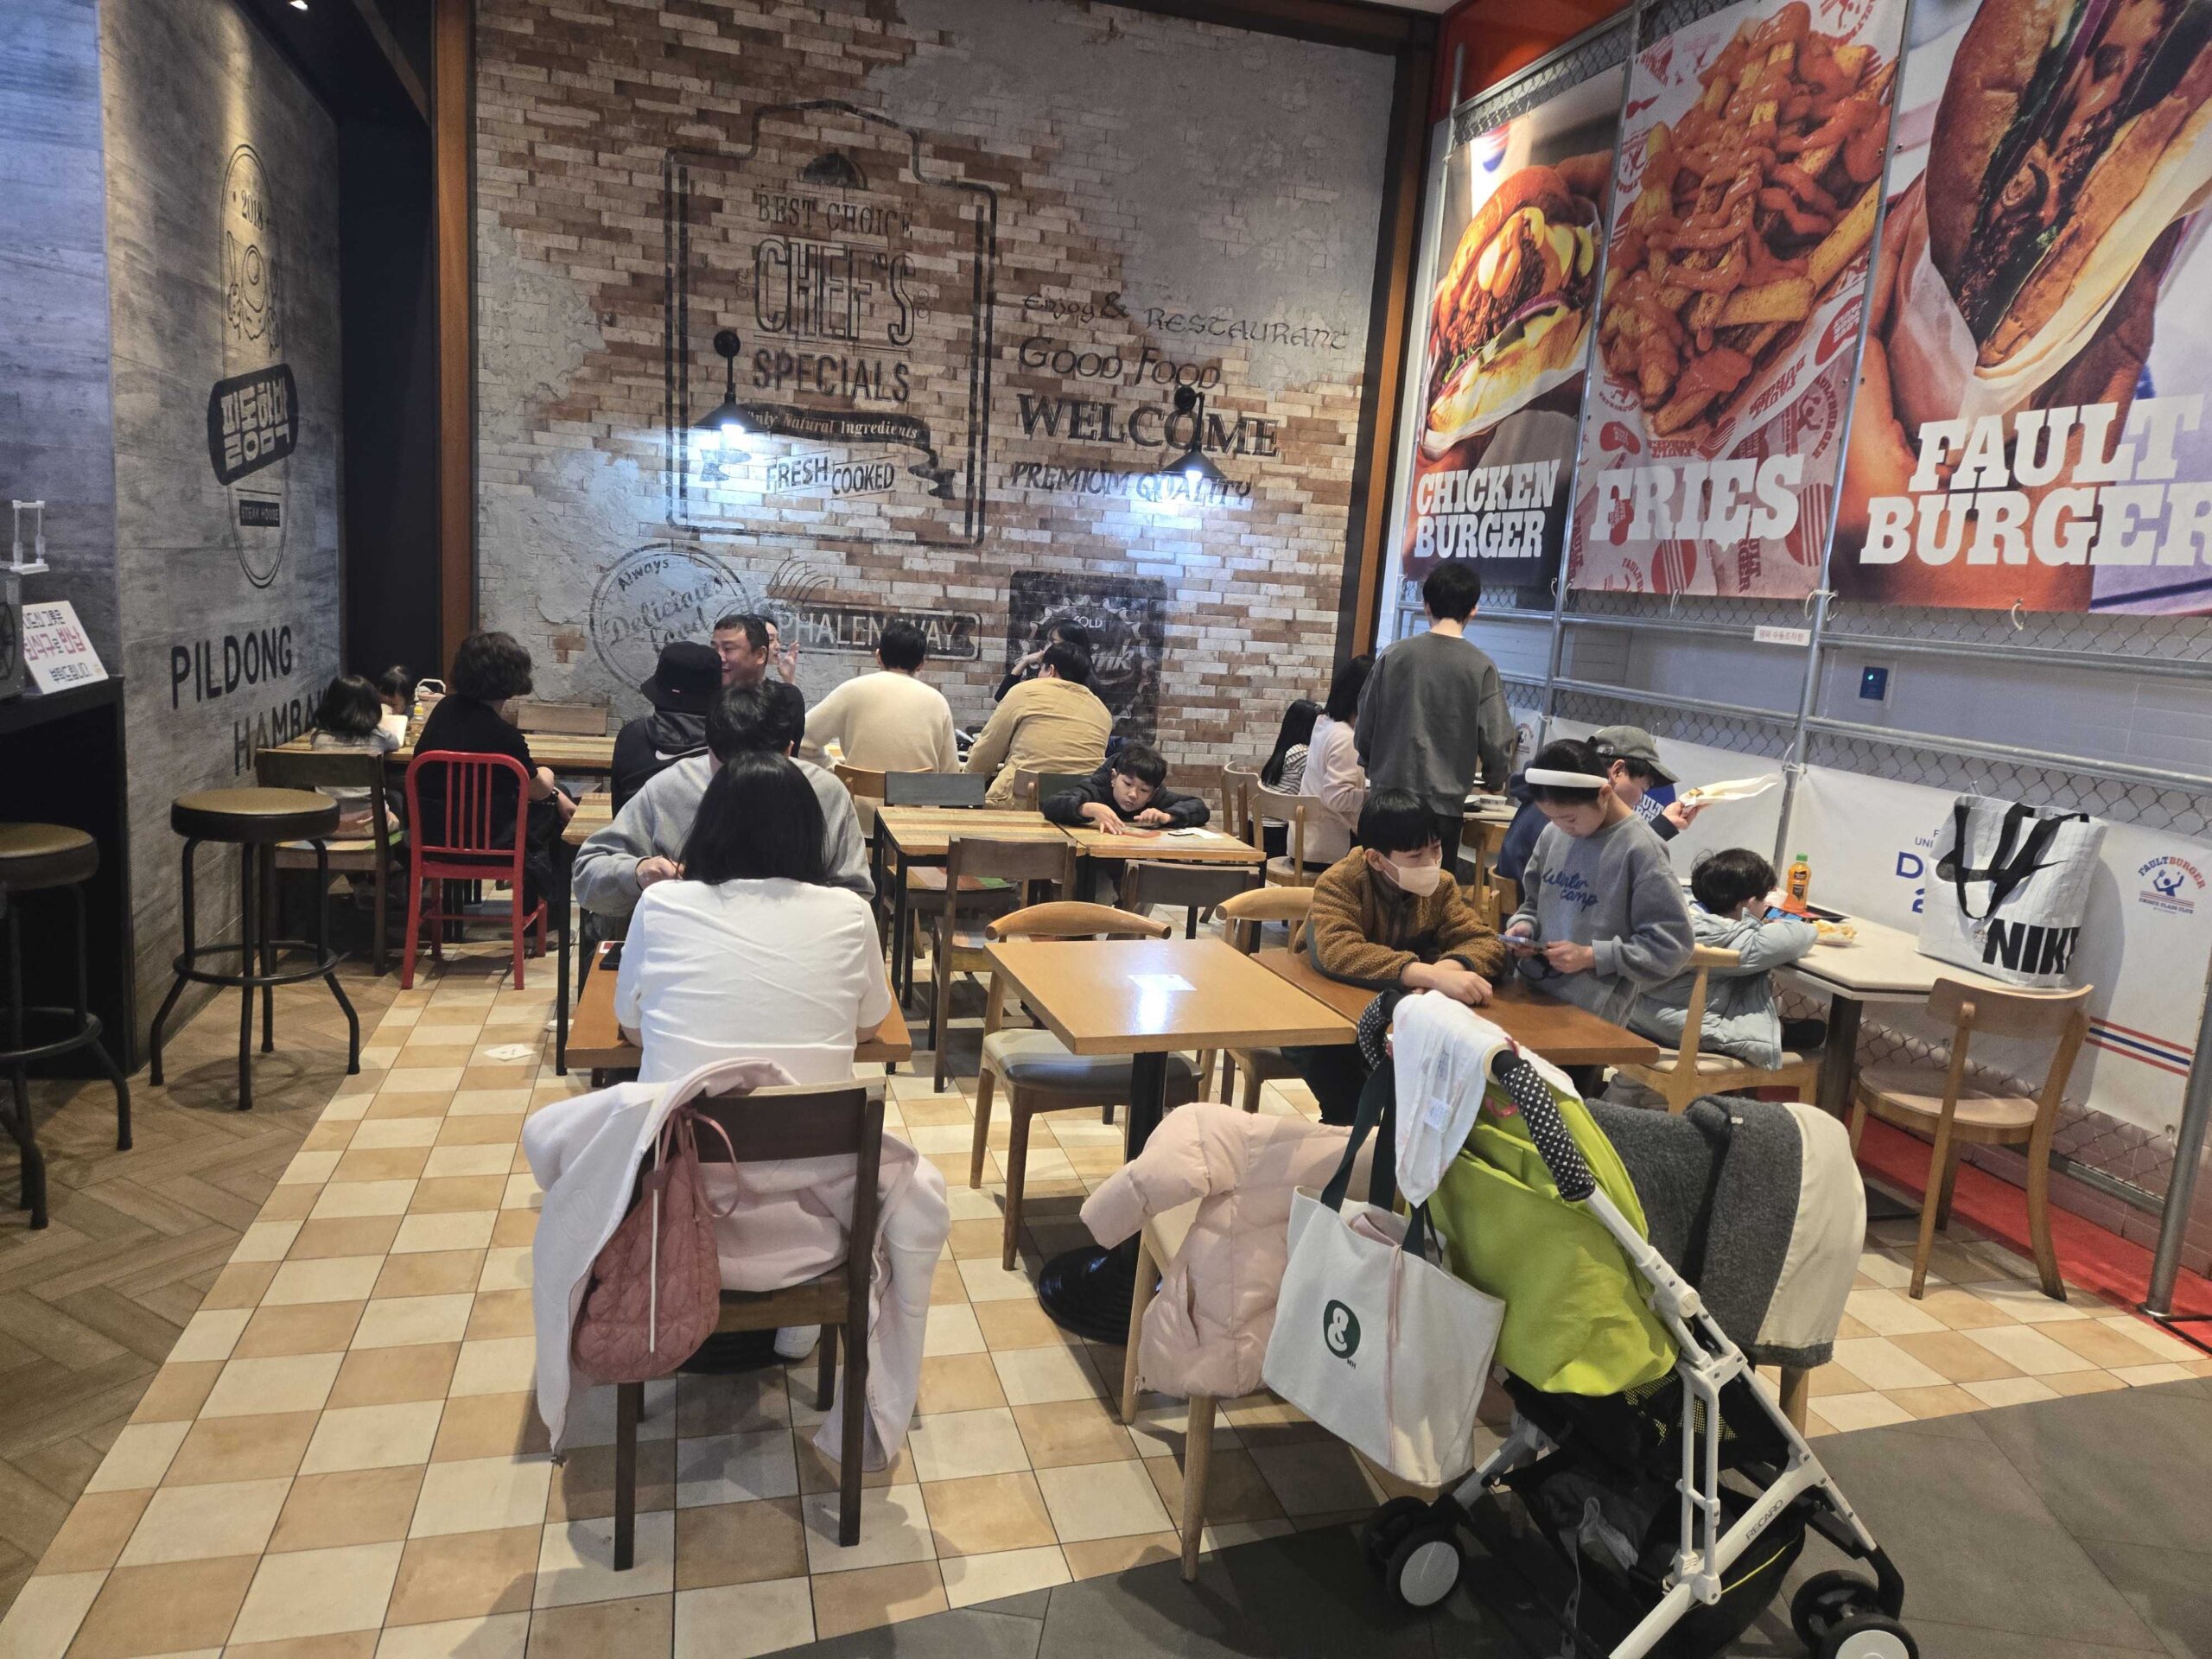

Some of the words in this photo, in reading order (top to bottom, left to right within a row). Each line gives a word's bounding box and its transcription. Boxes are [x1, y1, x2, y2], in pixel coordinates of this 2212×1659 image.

[242, 189, 263, 231] 2018
[756, 192, 817, 230] BEST
[826, 202, 912, 239] CHOICE
[754, 238, 916, 346] CHEF'S
[1100, 291, 1129, 319] &
[753, 347, 911, 403] SPECIALS
[220, 377, 289, 471] 필동함박
[784, 413, 834, 434] Natural
[840, 421, 918, 440] Ingredients
[1017, 392, 1280, 457] WELCOME
[1908, 394, 2204, 492] FAULT
[766, 452, 828, 491] FRESH
[831, 462, 895, 495] COOKED
[1011, 461, 1133, 495] PREMIUM
[1416, 459, 1561, 515] CHICKEN
[1589, 454, 1804, 548] FRIES
[1859, 481, 2212, 566] BURGER
[1414, 511, 1546, 559] BURGER
[617, 559, 669, 591] Always
[171, 626, 292, 709] PILDONG
[1541, 868, 1588, 889] Winter
[1560, 887, 1599, 912] camp
[1745, 1499, 1783, 1540] RECARO
